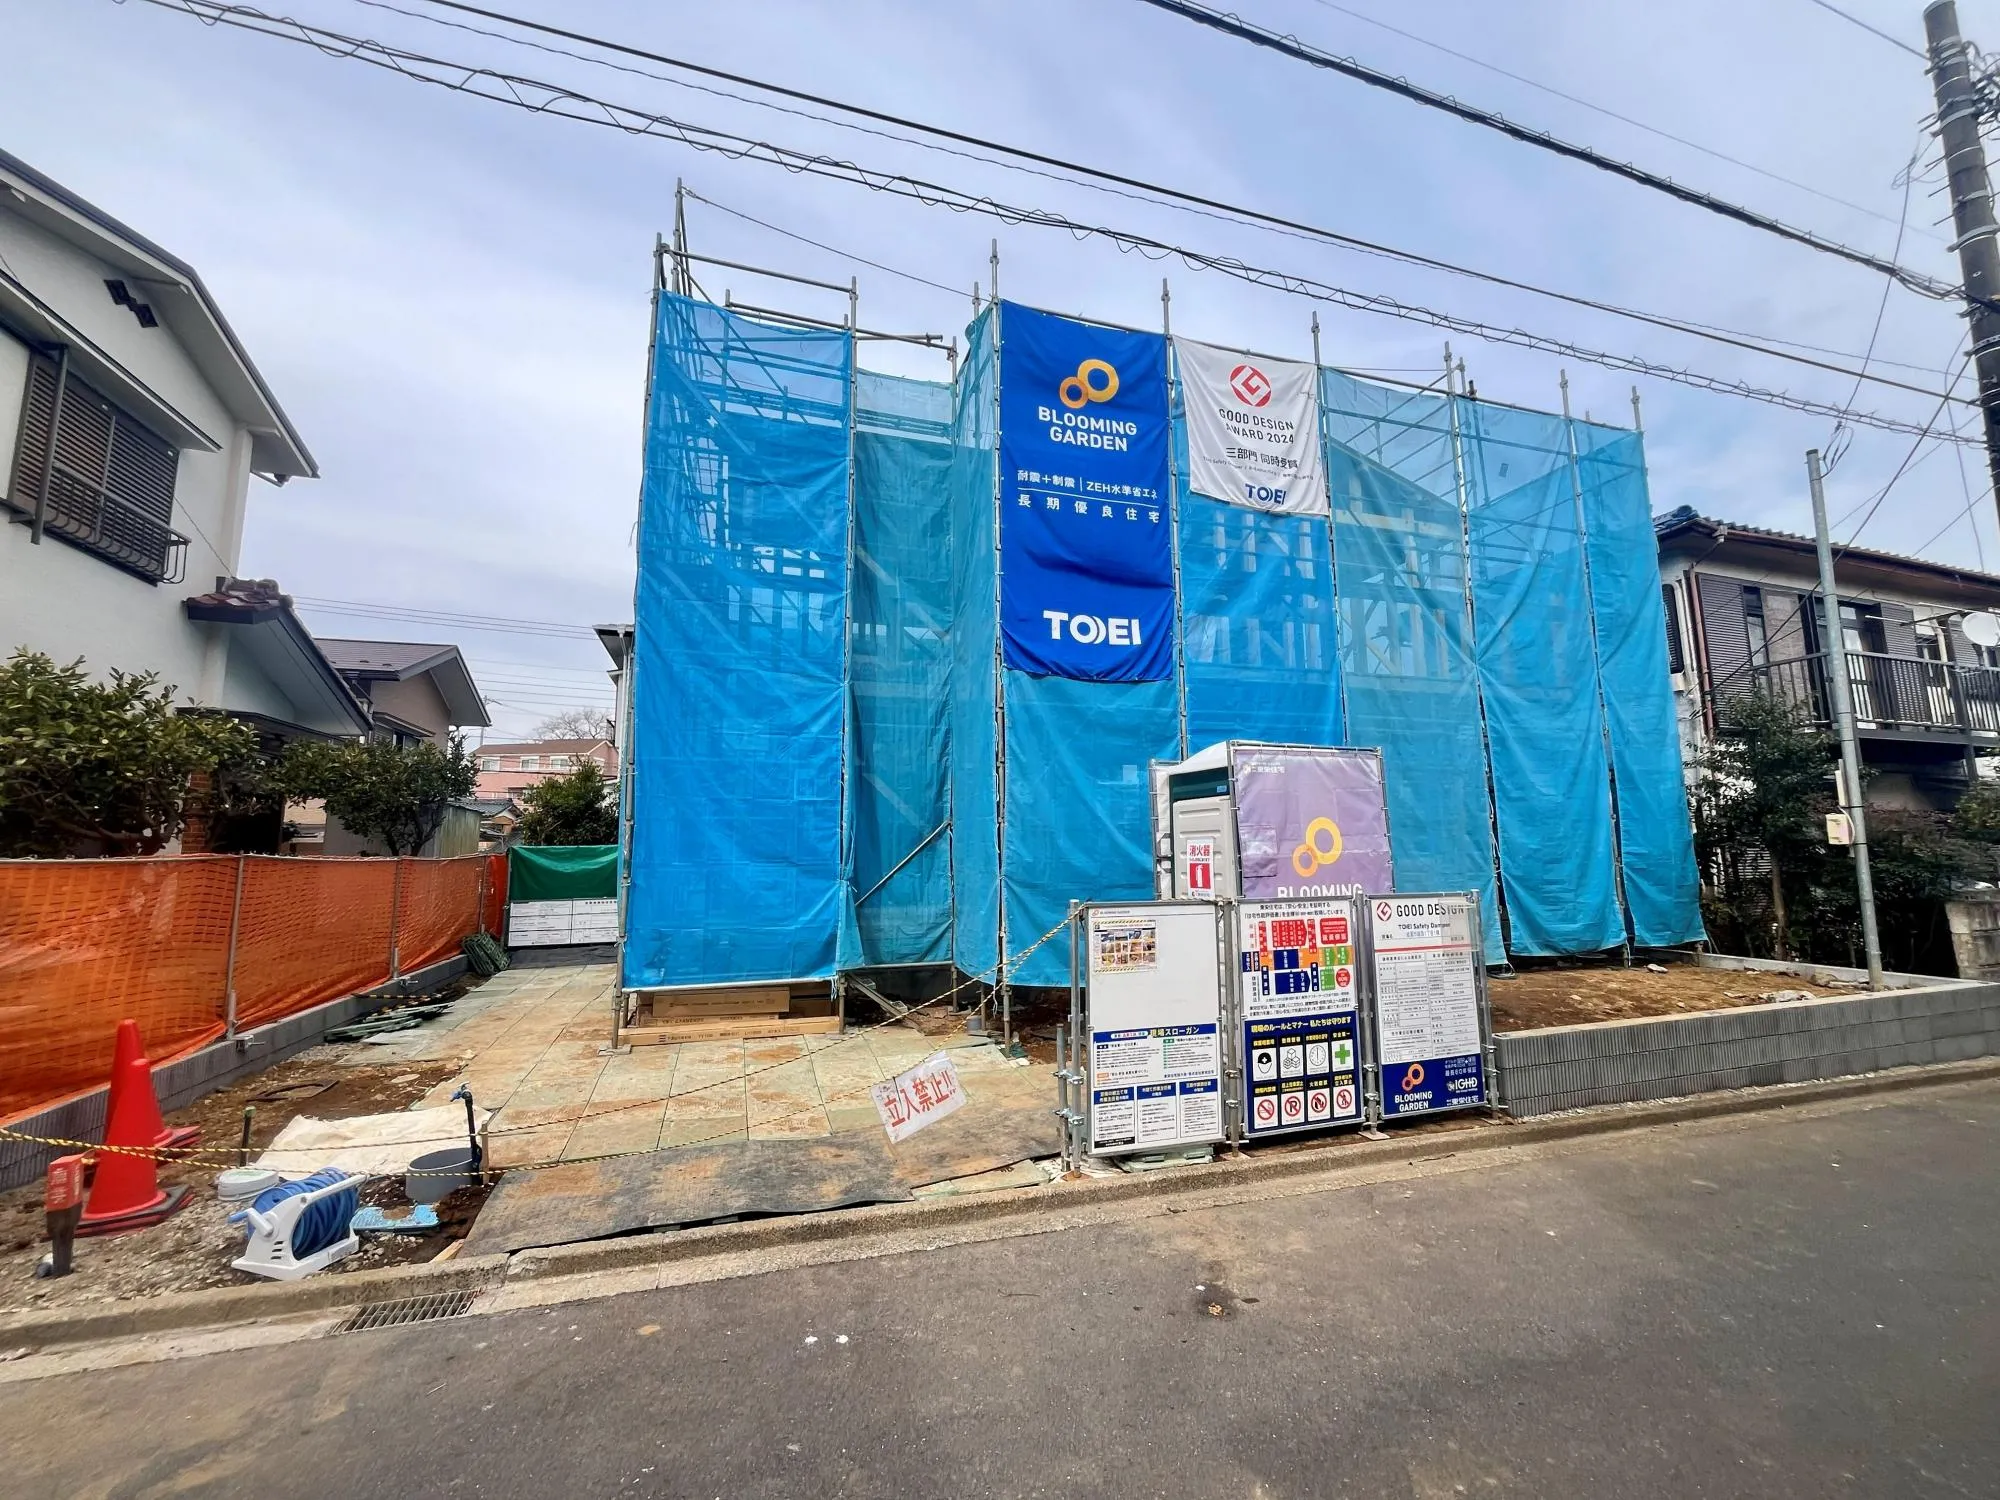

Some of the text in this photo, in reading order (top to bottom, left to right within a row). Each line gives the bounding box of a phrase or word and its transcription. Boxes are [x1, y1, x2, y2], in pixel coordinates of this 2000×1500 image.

[1038, 406, 1138, 436] BLOOMING
[1219, 408, 1295, 431] GOOD DESIGN
[1050, 426, 1128, 452] GARDEN
[1225, 423, 1295, 445] AWARD 2024
[1225, 447, 1259, 462] 三部門
[1086, 481, 1158, 500] ZEH水準省エネ
[1245, 483, 1287, 505] TOEI
[1018, 494, 1160, 523] 長期優良住宅
[1043, 610, 1142, 646] TOEI
[1189, 845, 1211, 857] 消火器
[1396, 903, 1465, 917] GOOD DESIGN
[1413, 922, 1430, 930] Safety
[1394, 1090, 1433, 1104] BLOOMING
[1399, 1101, 1429, 1112] GARDEN
